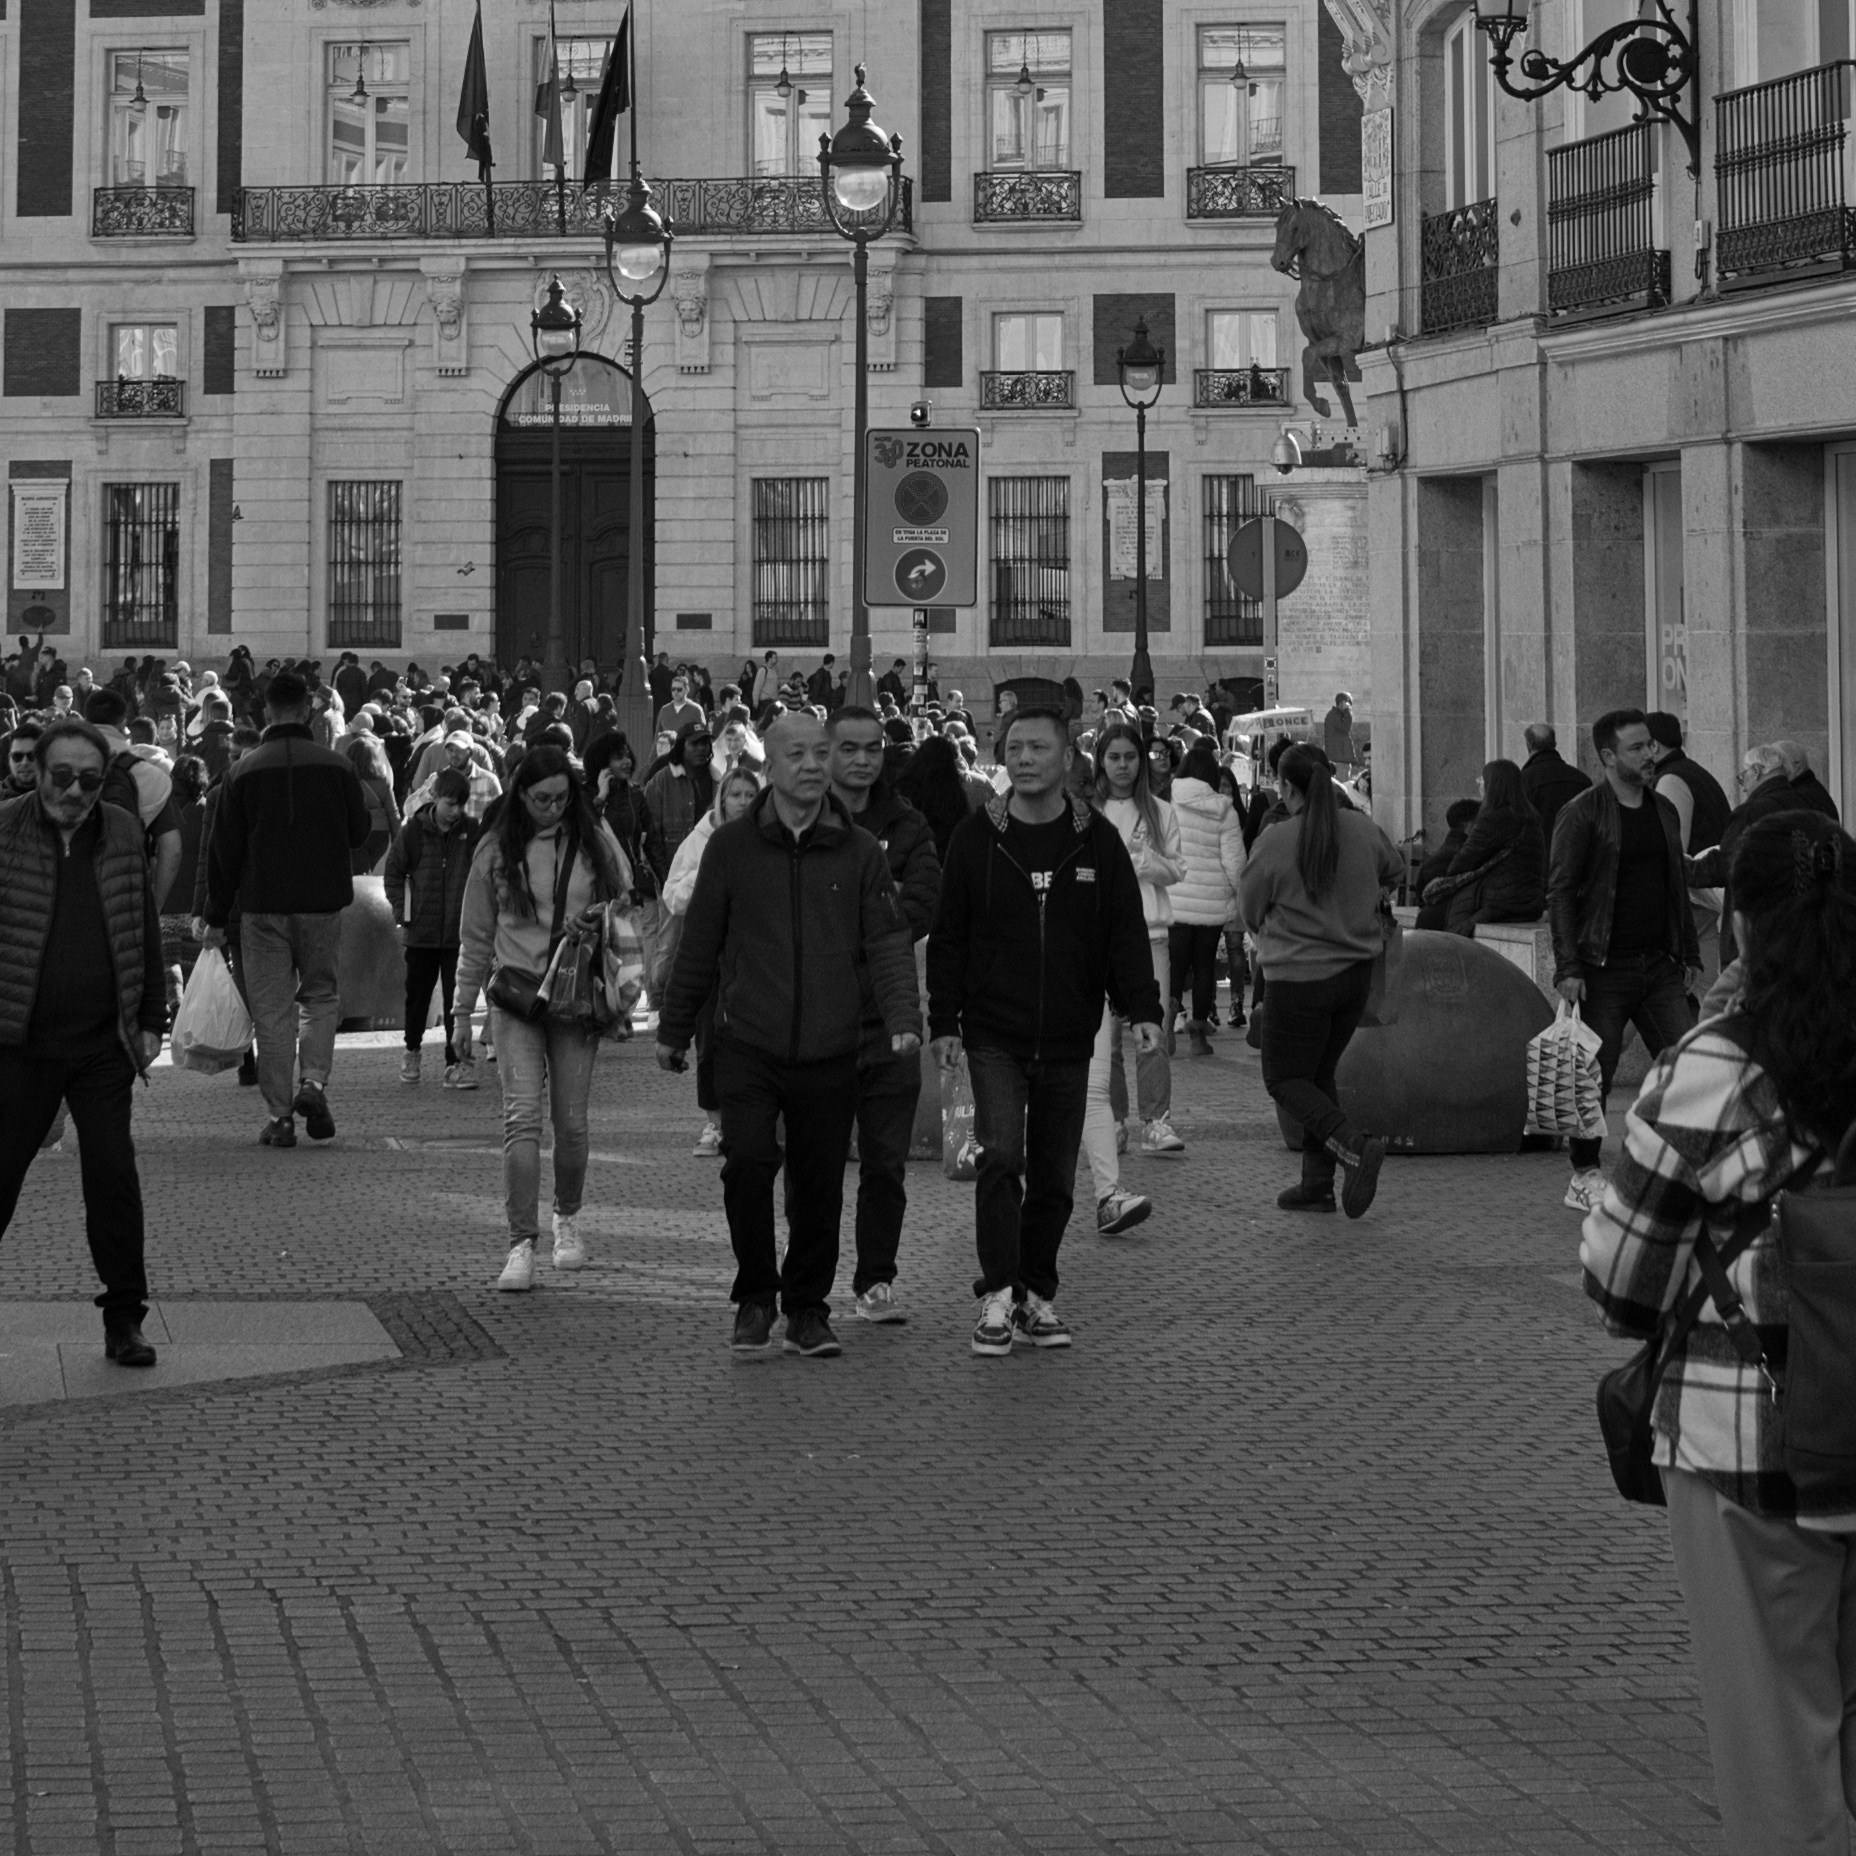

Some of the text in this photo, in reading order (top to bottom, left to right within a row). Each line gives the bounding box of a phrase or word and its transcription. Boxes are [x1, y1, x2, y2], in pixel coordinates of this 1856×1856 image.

[518, 414, 579, 424] COMUNDAD
[581, 414, 594, 423] DE
[906, 442, 969, 458] ZONA
[906, 459, 970, 468] PEATONAL
[1276, 716, 1307, 726] ONCE
